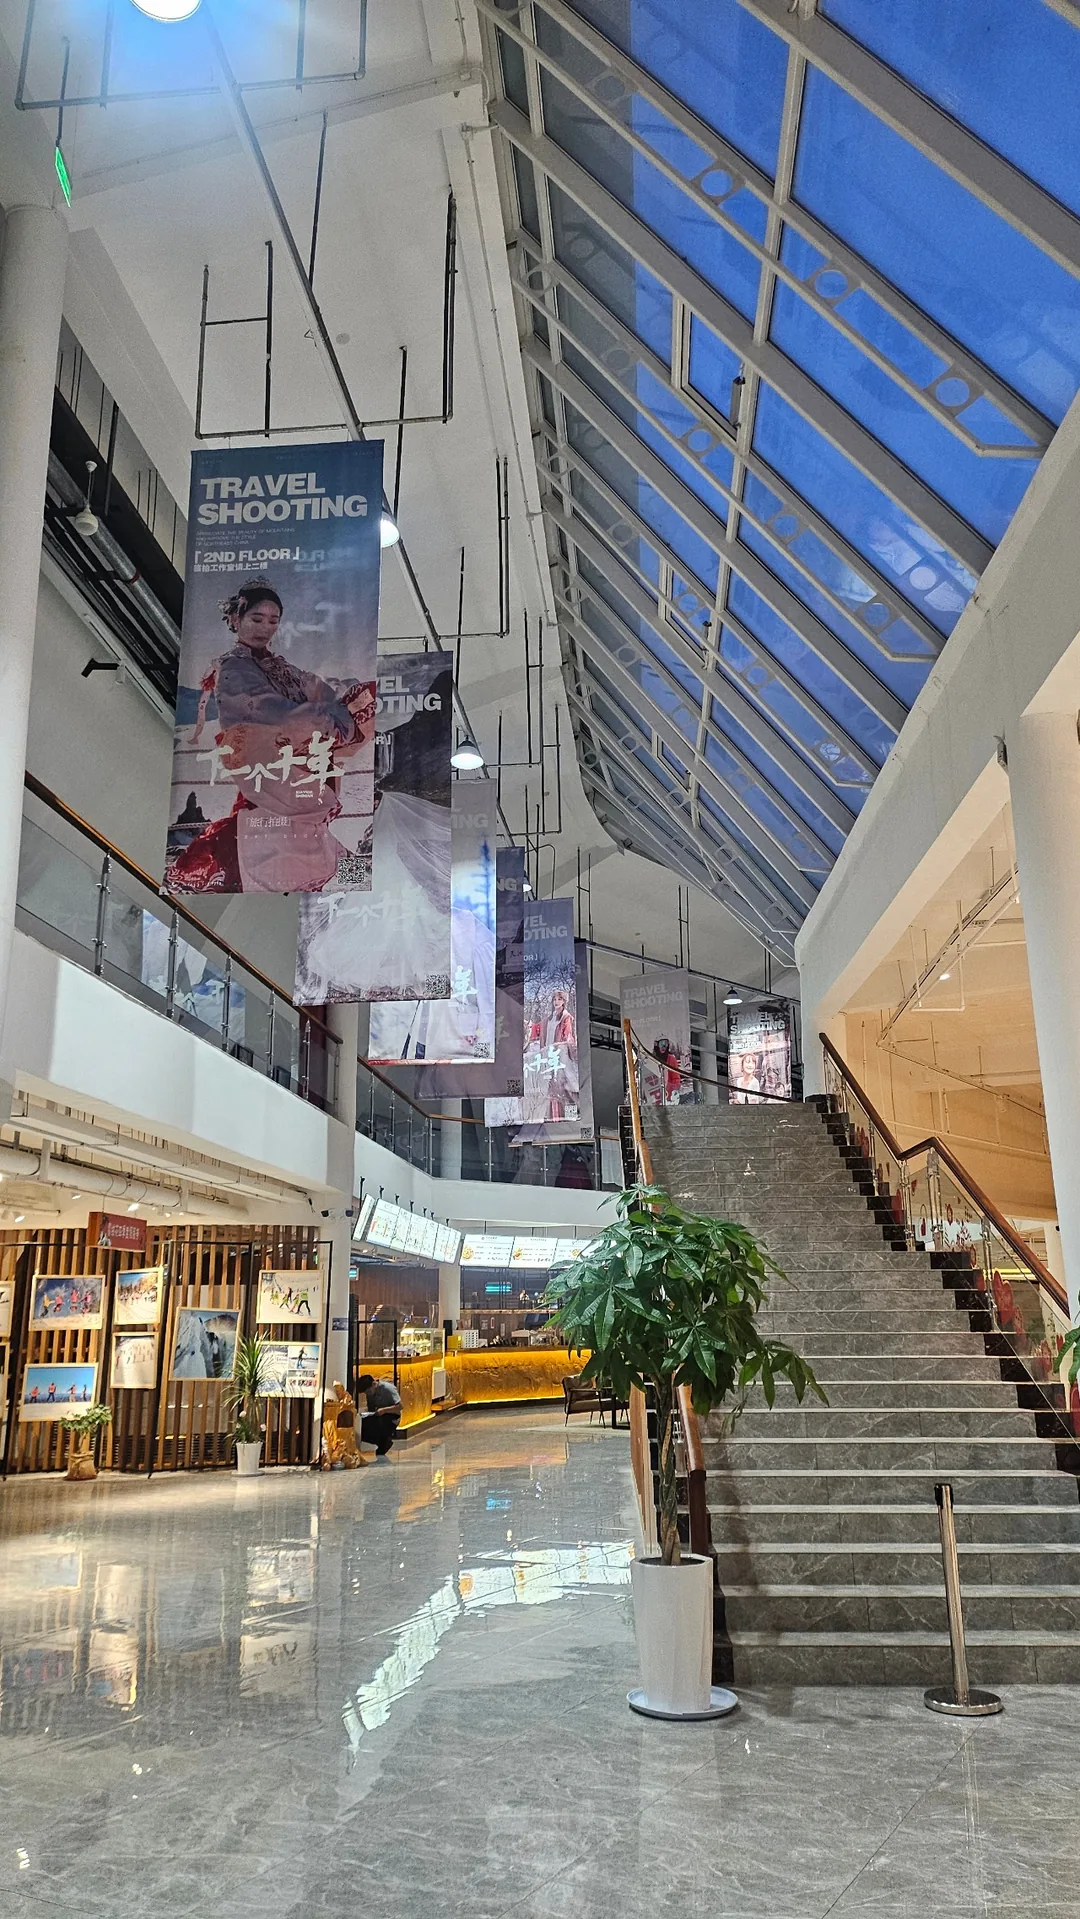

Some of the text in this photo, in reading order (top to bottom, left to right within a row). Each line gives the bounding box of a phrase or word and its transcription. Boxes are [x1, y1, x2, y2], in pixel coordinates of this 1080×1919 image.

[200, 472, 326, 500] TRAVEL
[197, 495, 368, 526] SHOOTING
[623, 983, 668, 998] TRAVEL
[624, 991, 683, 1010] SHOOTING
[730, 1011, 770, 1024] TRAVEL
[730, 1020, 786, 1034] SHOOTING
